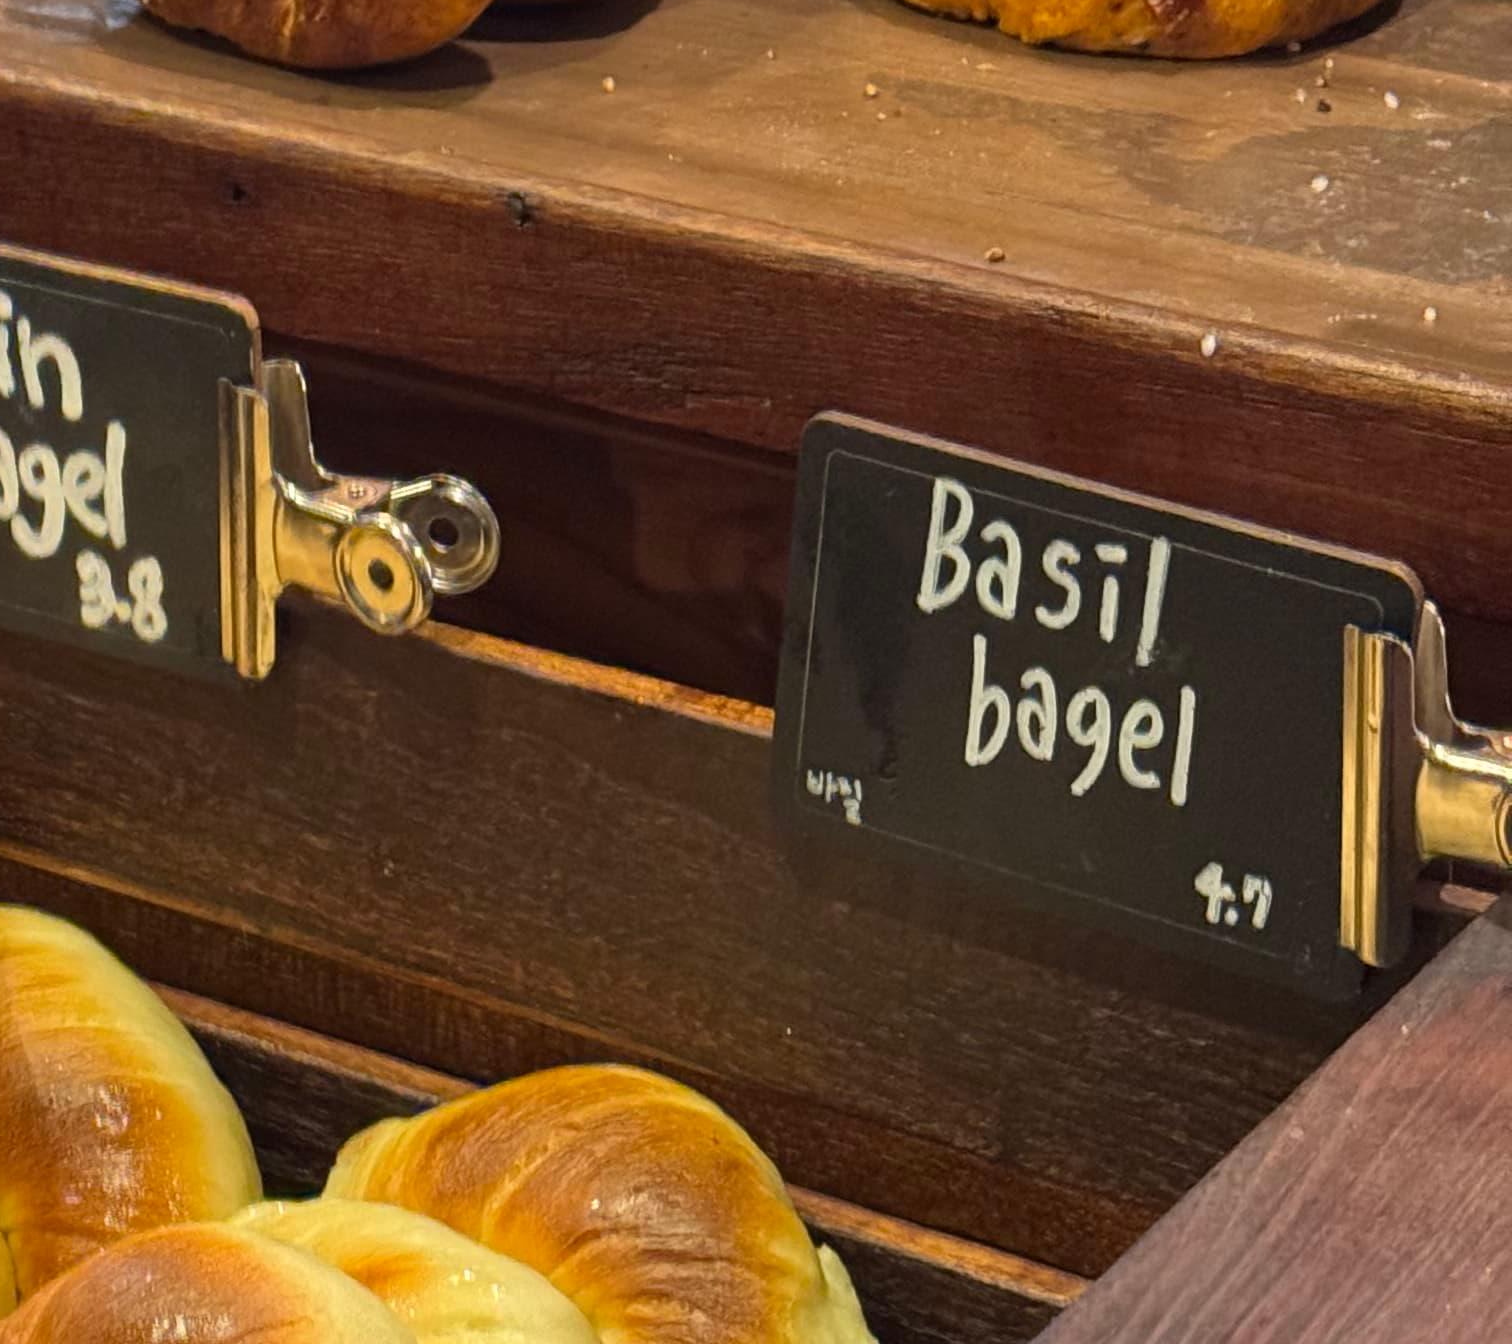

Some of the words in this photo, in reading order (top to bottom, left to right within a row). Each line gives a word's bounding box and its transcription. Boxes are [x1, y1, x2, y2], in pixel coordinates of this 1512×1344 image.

[74, 548, 170, 644] 3.8
[916, 476, 1173, 668] Basil
[963, 632, 1197, 808] bagel
[1193, 861, 1274, 930] 4.7
